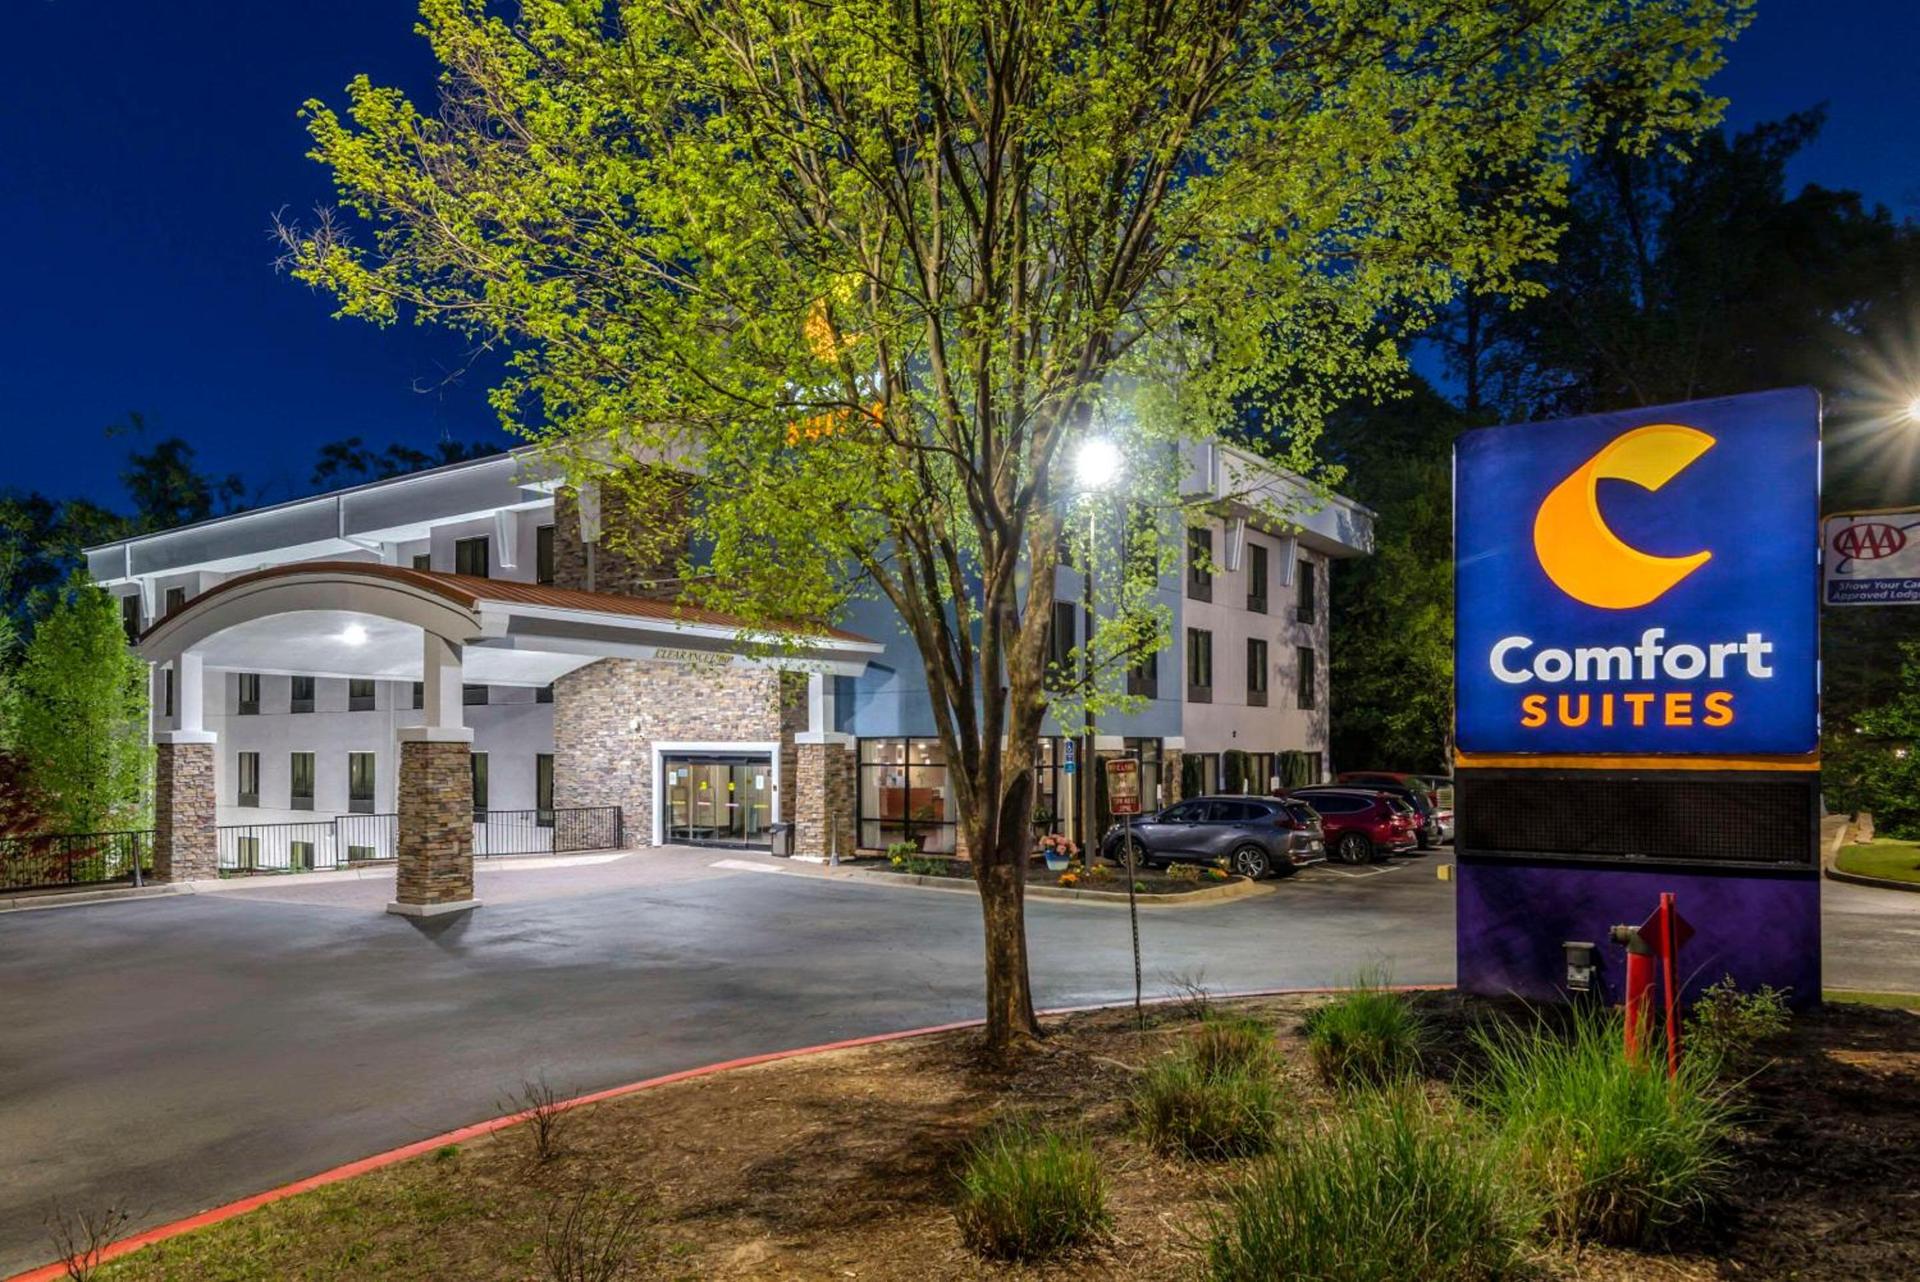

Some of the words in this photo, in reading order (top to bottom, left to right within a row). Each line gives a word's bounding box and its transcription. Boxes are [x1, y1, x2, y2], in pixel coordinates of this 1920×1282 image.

[1839, 523, 1900, 560] AAA
[1832, 590, 1888, 601] Approved
[1890, 590, 1920, 600] Lodg
[1874, 581, 1901, 590] Your
[1489, 627, 1774, 684] Comfort
[1520, 691, 1735, 728] SUITES
